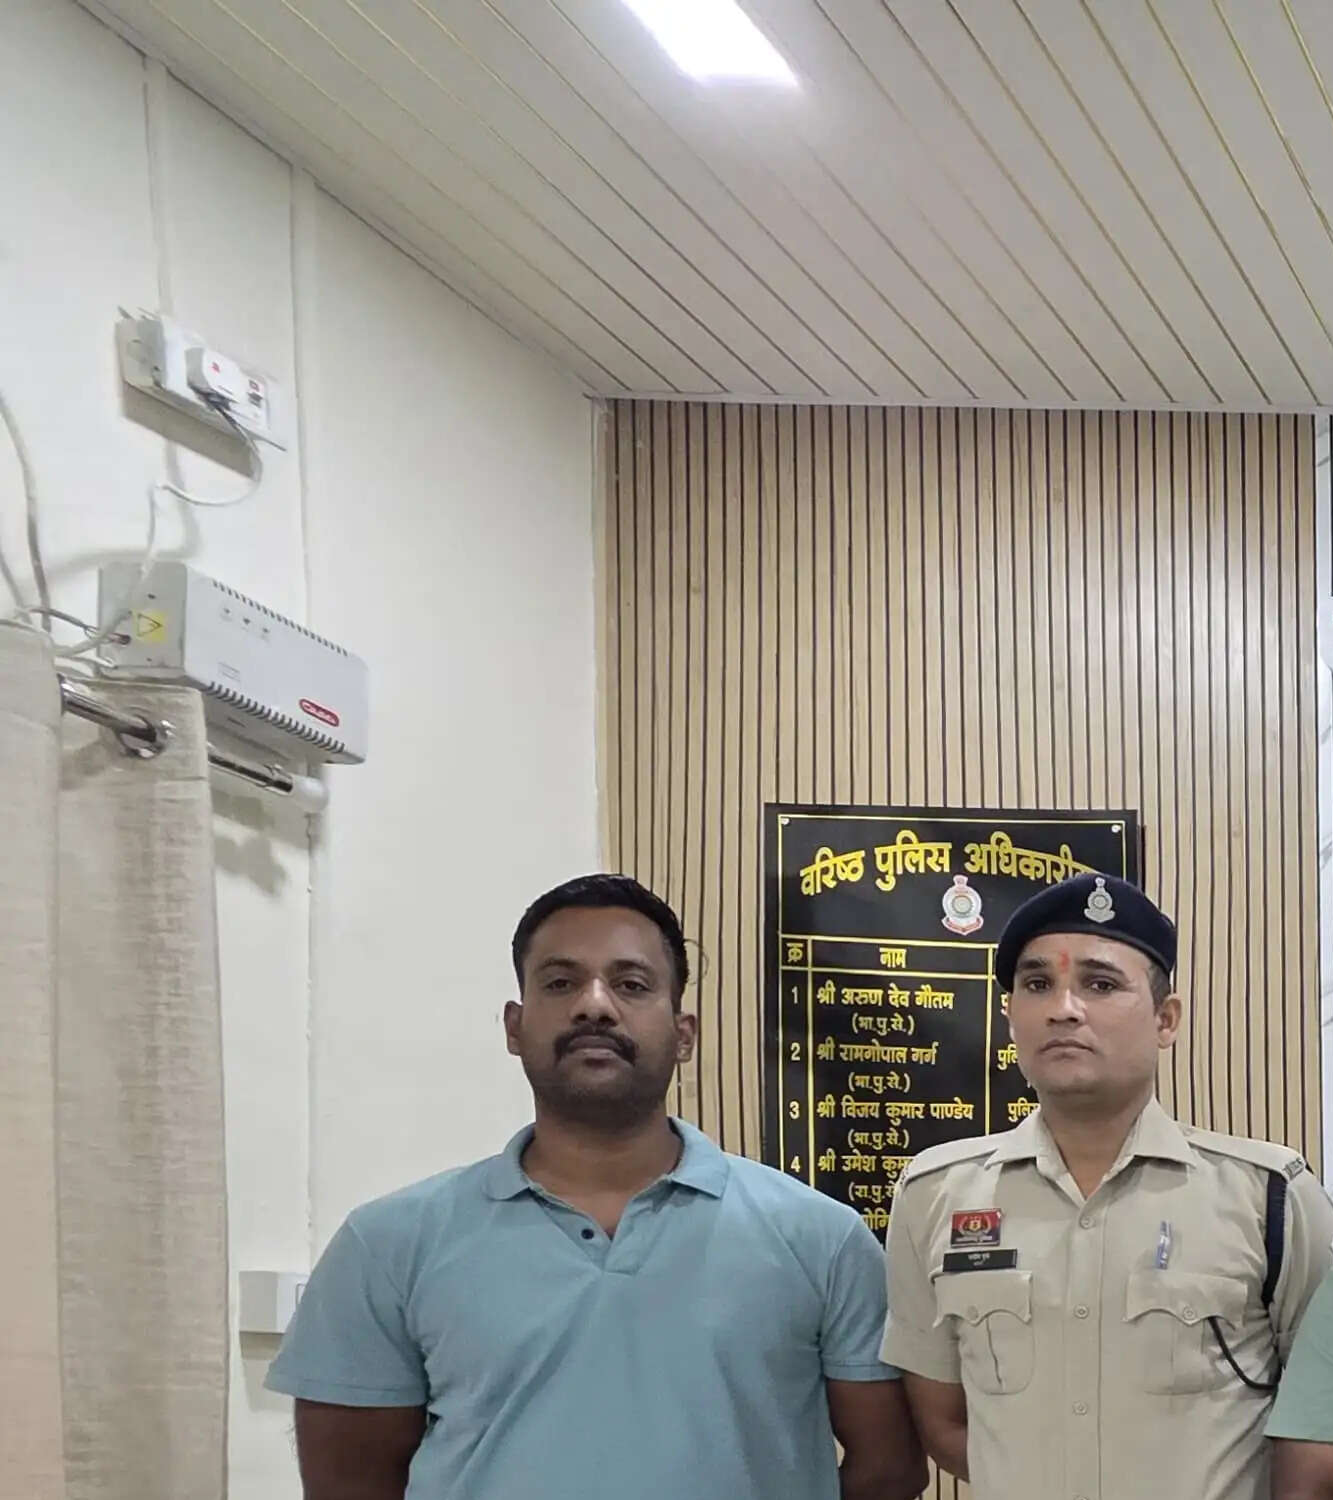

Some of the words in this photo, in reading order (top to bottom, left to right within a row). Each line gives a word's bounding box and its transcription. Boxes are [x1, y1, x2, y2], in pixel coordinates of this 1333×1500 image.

[800, 846, 865, 897] वरिष्ठ
[874, 829, 953, 891] पुलिस
[880, 947, 906, 969] नाम
[791, 988, 798, 1004] 1
[816, 986, 836, 1006] श्री
[841, 988, 883, 1006] अरुण
[888, 984, 909, 1008] देव
[914, 985, 955, 1009] गौतम
[791, 1042, 801, 1062] 2
[816, 1037, 836, 1062] श्री
[840, 1039, 908, 1065] रामगोपाल
[912, 1042, 939, 1065] गर्ग
[789, 1101, 800, 1120] 3
[816, 1095, 836, 1119] श्री
[841, 1096, 880, 1119] विजय
[886, 1102, 925, 1127] कुमार
[930, 1097, 974, 1120] पाण्डेय
[790, 1156, 801, 1173] 4
[817, 1149, 836, 1172] श्री
[841, 1150, 876, 1173] उमेश
